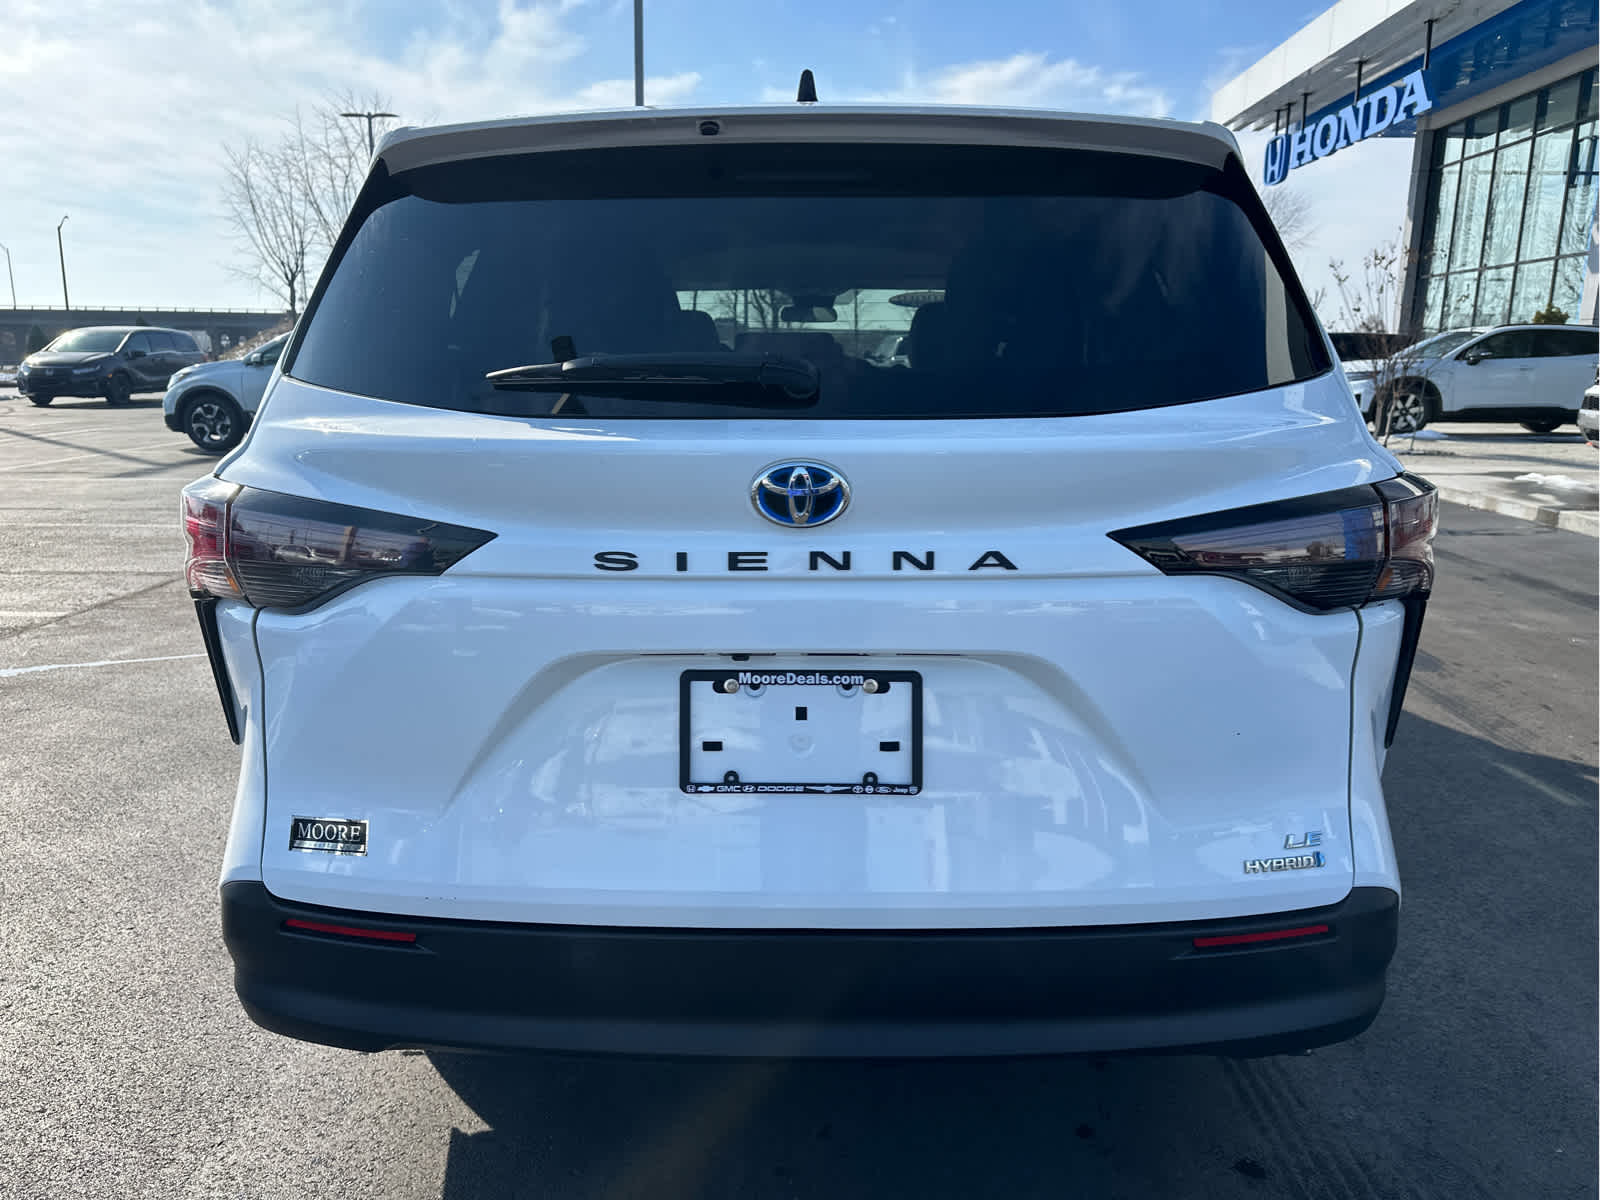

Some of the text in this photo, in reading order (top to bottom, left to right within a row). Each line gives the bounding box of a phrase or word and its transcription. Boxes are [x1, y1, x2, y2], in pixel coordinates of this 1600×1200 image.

[1289, 69, 1432, 169] HONDA
[593, 551, 1018, 571] SIENNA
[738, 672, 864, 685] MooreDeals.com
[716, 785, 741, 793] GMC
[757, 785, 805, 793] DODGE
[297, 822, 361, 842] MOORE
[1284, 831, 1322, 849] LE
[1243, 855, 1315, 873] HYBRID
